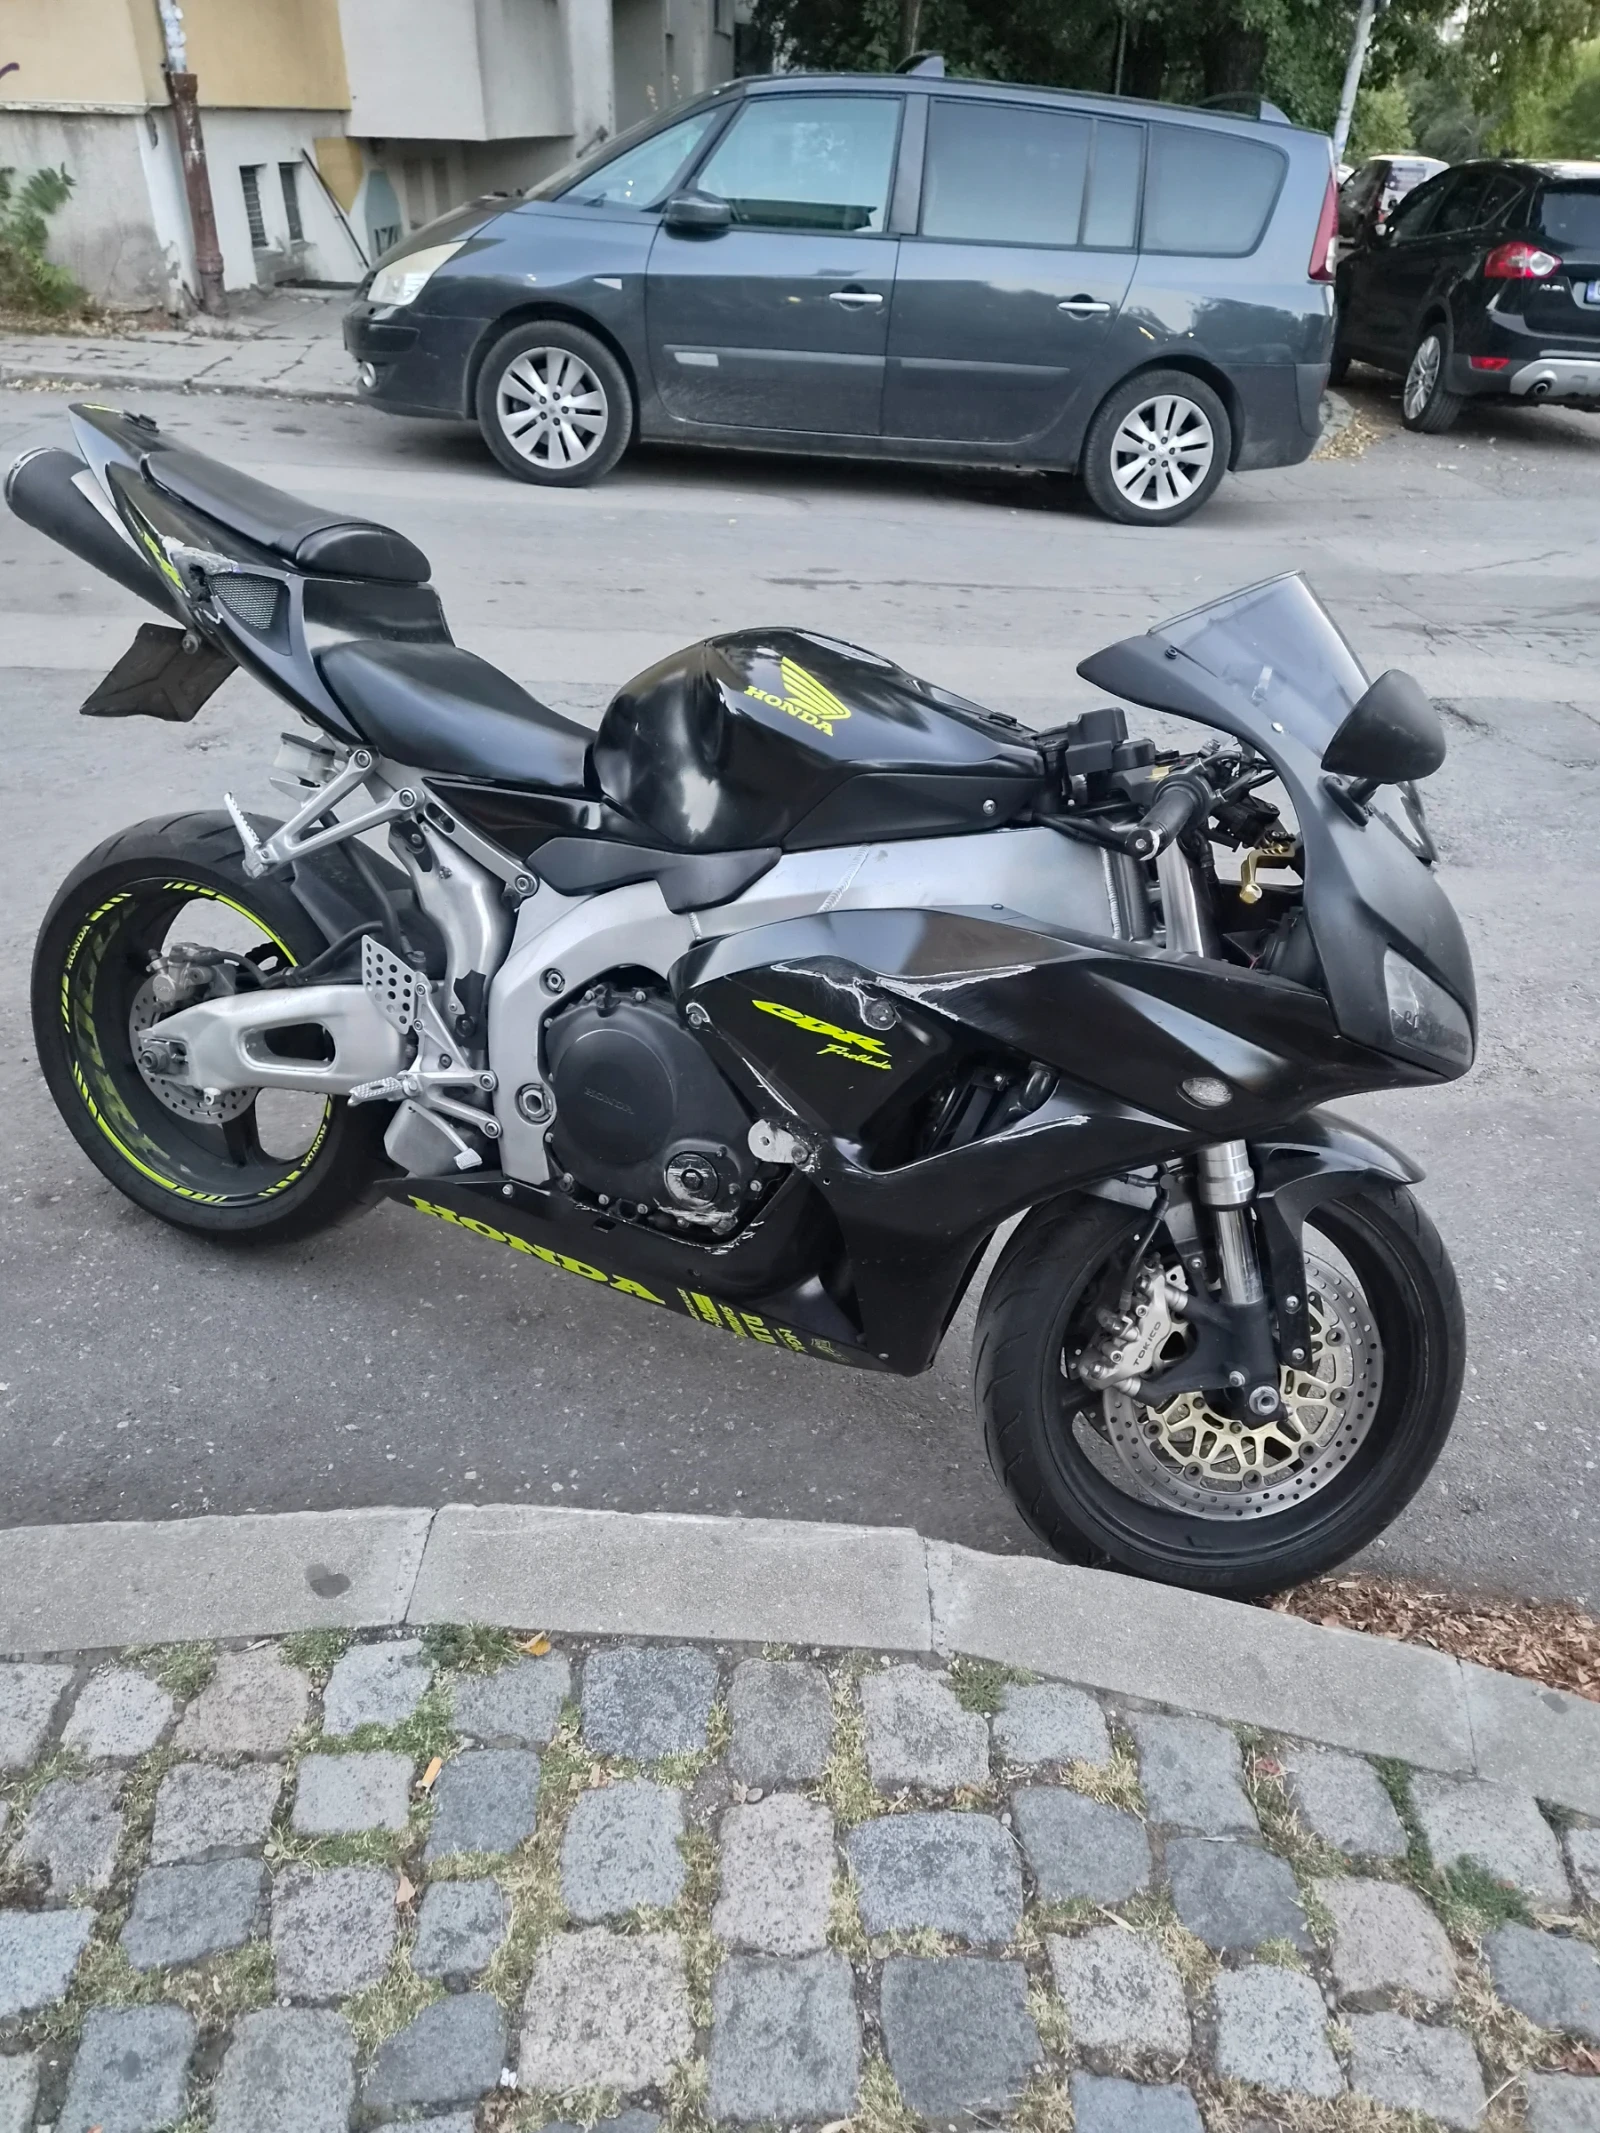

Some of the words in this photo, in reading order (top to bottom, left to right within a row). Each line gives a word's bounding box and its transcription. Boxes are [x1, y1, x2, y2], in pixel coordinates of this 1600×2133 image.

[743, 685, 834, 737] HONDA
[65, 925, 91, 970] HONDA
[583, 1086, 635, 1115] HONDA
[300, 1123, 328, 1167] HONDA
[407, 1194, 667, 1305] HONDA
[778, 1327, 809, 1354] NGK
[1132, 1321, 1162, 1367] TOKICO
